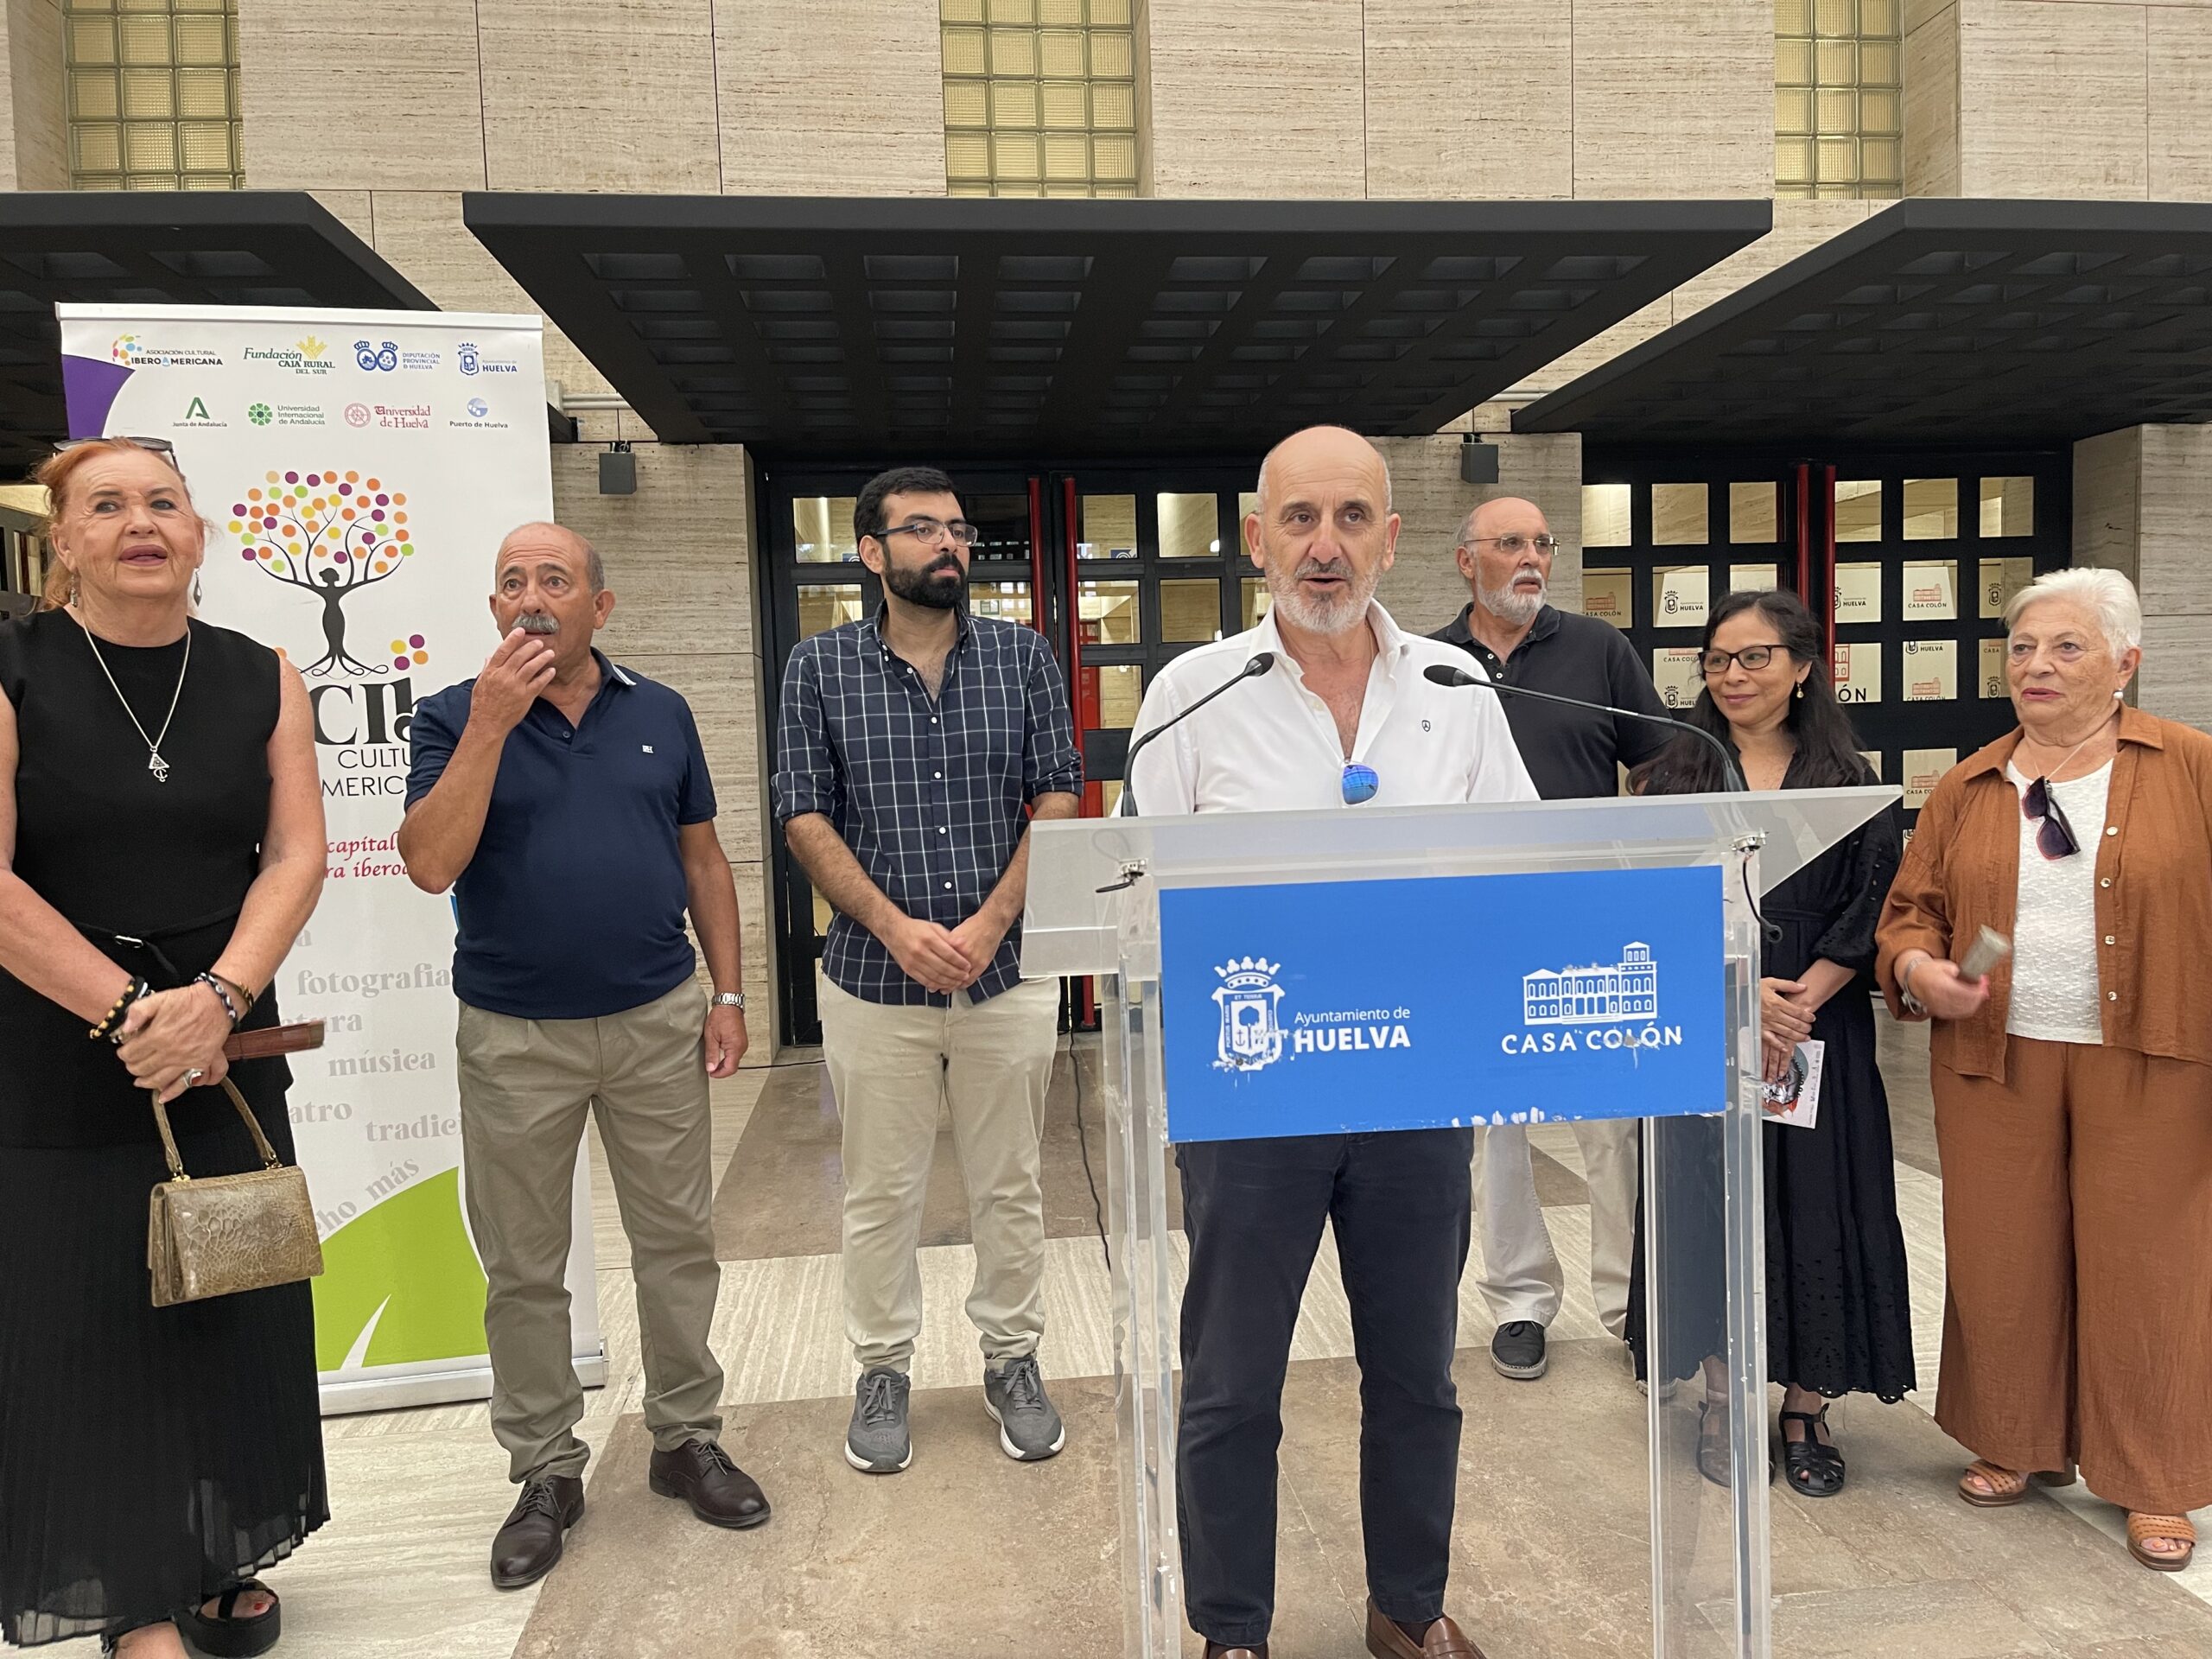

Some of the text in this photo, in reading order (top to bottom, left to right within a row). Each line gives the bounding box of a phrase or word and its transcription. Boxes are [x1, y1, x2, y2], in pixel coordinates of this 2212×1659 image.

[243, 347, 302, 361] Fundación
[303, 360, 336, 369] RURAL
[373, 404, 432, 416] Universidad
[379, 416, 429, 429] de Huelva
[1838, 683, 1866, 702] ÓN
[327, 830, 399, 861] capital
[1294, 1006, 1411, 1027] Ayuntamiento de
[1294, 1025, 1411, 1052] HUELVA
[1502, 1021, 1682, 1055] CASA COLÓN
[328, 1048, 436, 1077] música
[365, 1159, 420, 1201] más
